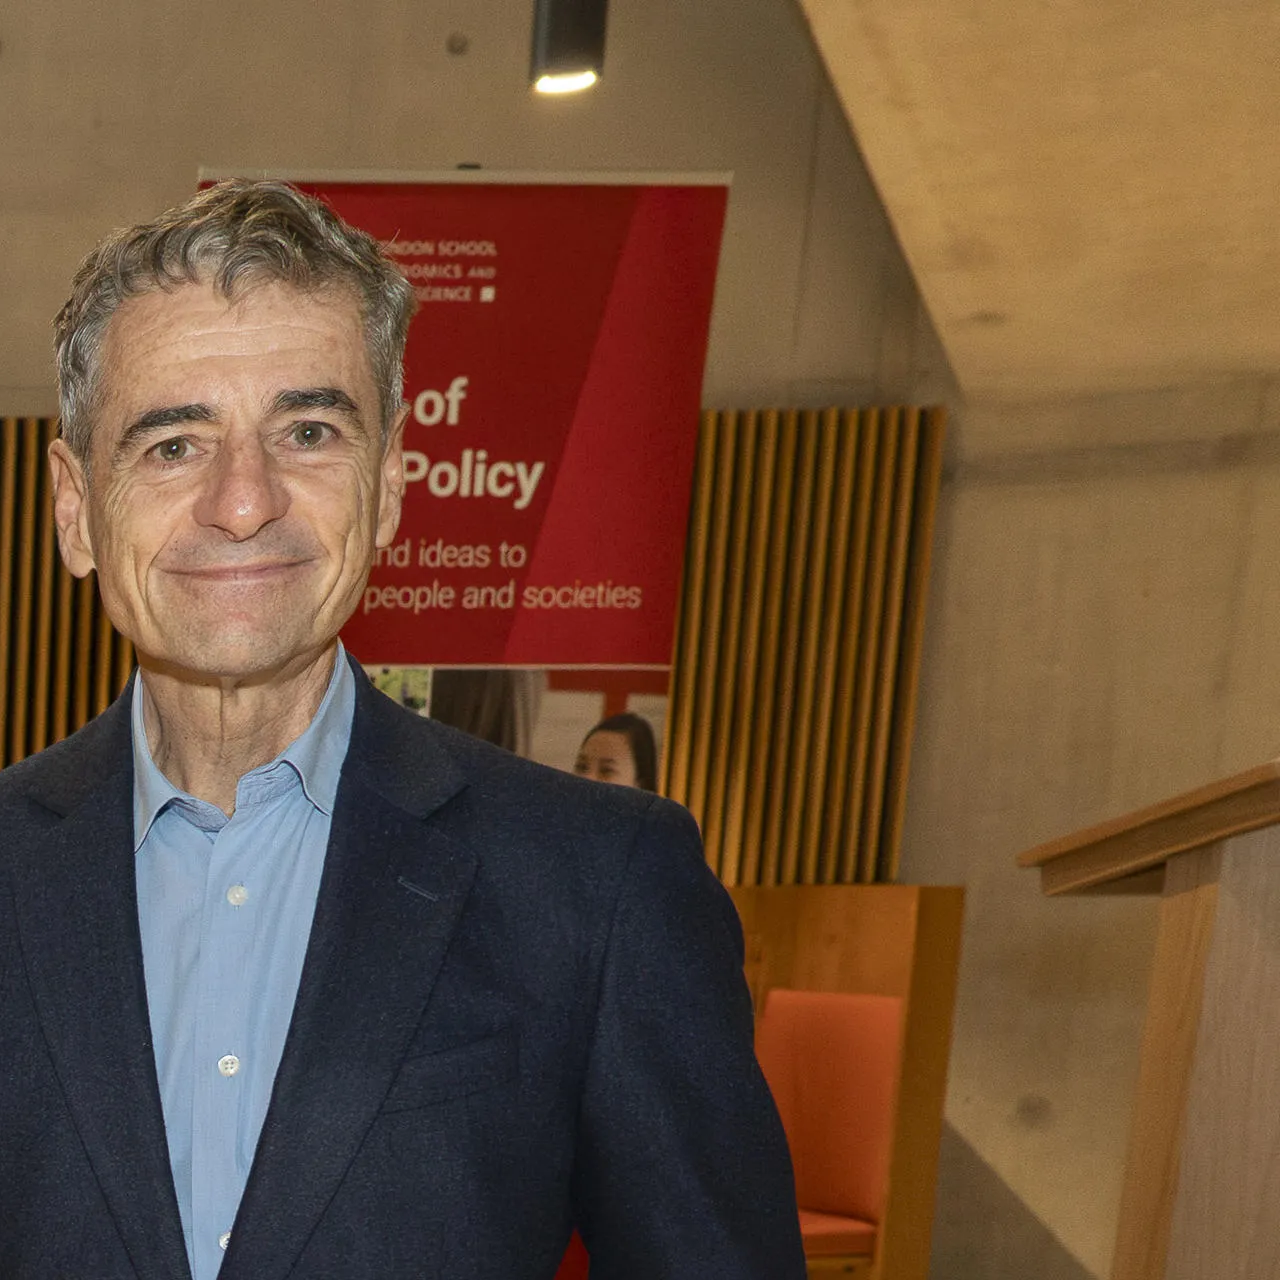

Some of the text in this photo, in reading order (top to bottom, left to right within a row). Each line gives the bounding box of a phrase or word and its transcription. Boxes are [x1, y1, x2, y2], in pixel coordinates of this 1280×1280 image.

[438, 239, 497, 257] SCHOOL
[414, 376, 469, 426] of
[402, 448, 545, 510] Policy
[418, 537, 491, 568] ideas
[498, 541, 527, 568] to
[363, 579, 642, 615] people and societies
